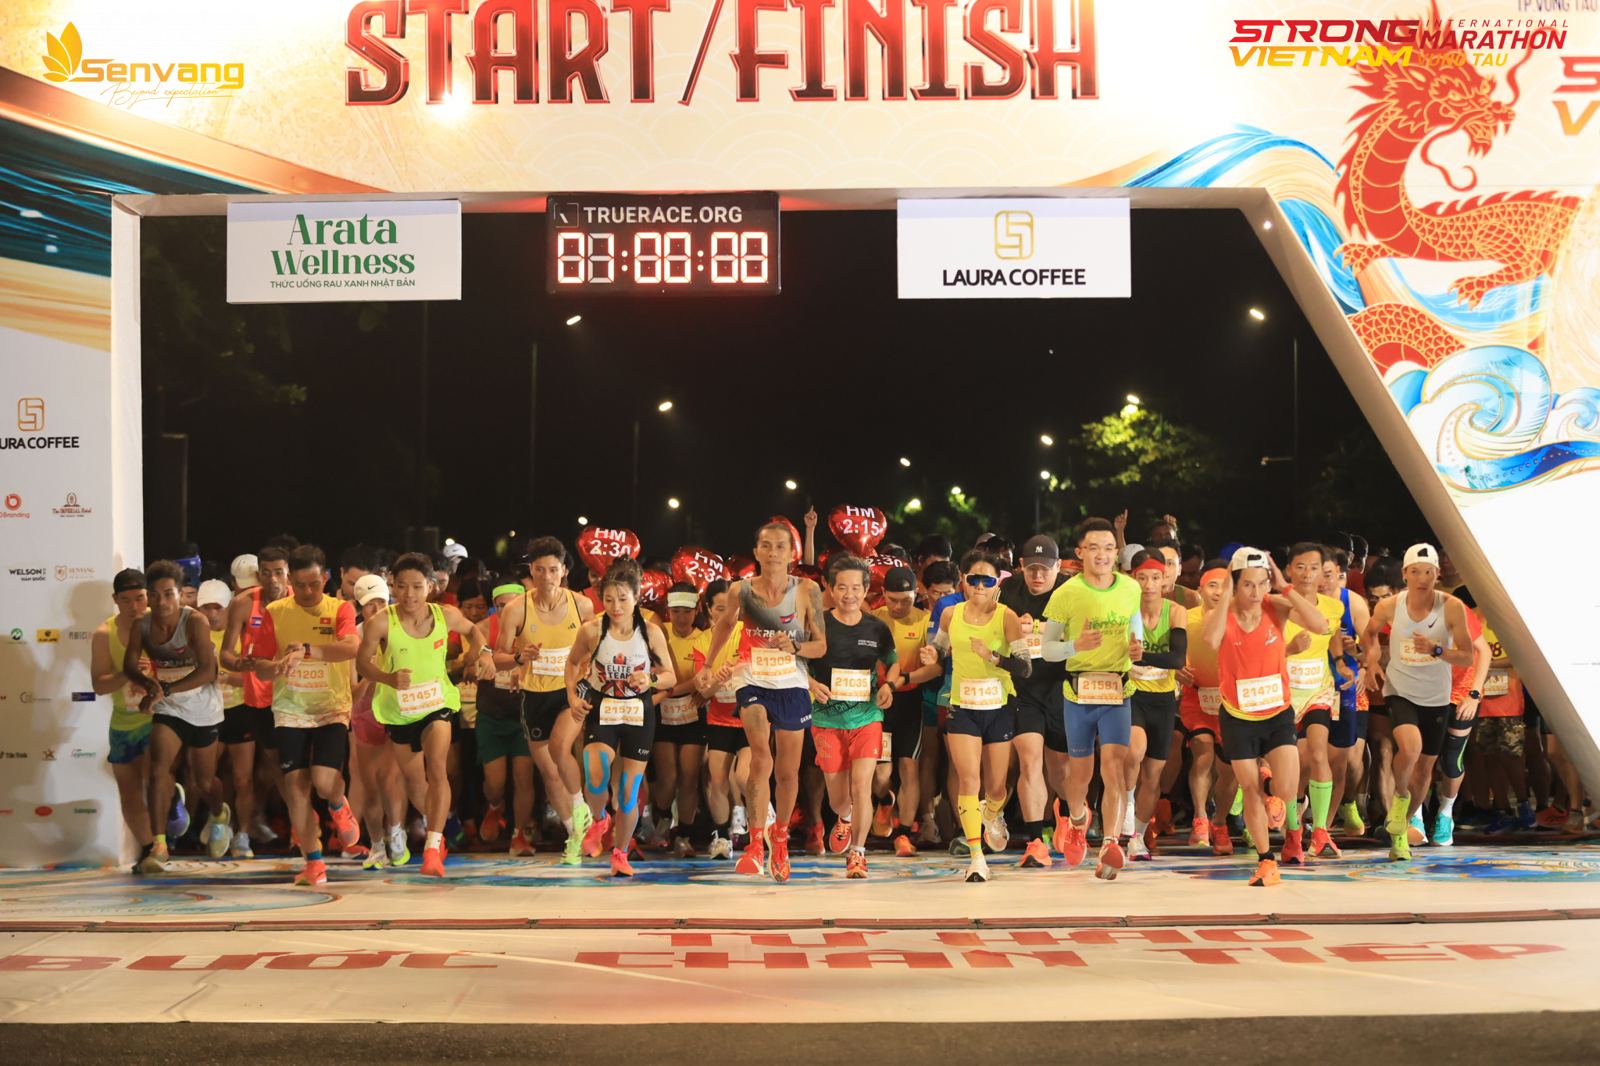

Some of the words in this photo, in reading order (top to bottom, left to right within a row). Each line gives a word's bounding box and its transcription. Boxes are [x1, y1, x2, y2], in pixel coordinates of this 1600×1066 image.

[345, 0, 1100, 106] START/FINISH
[583, 206, 743, 224] TRUERACE.ORG
[286, 213, 399, 246] Arata
[270, 249, 416, 276] Wellness
[270, 279, 295, 289] THỨC
[296, 279, 322, 288] UỐNG
[323, 280, 342, 288] RAU
[344, 280, 369, 288] XANH
[370, 279, 395, 289] NHẬT
[942, 269, 1007, 287] LAURA
[1009, 268, 1087, 286] COFFEE
[28, 436, 80, 449] COFFEE
[845, 505, 876, 518] HM
[594, 527, 627, 543] HM
[842, 518, 881, 537] 2:15
[694, 550, 725, 573] HM
[9, 568, 42, 576] WELSON
[755, 654, 792, 667] 21309
[606, 664, 632, 674] ELITE
[835, 676, 868, 688] 21035
[1242, 683, 1279, 698] 21470
[604, 705, 640, 715] 21577
